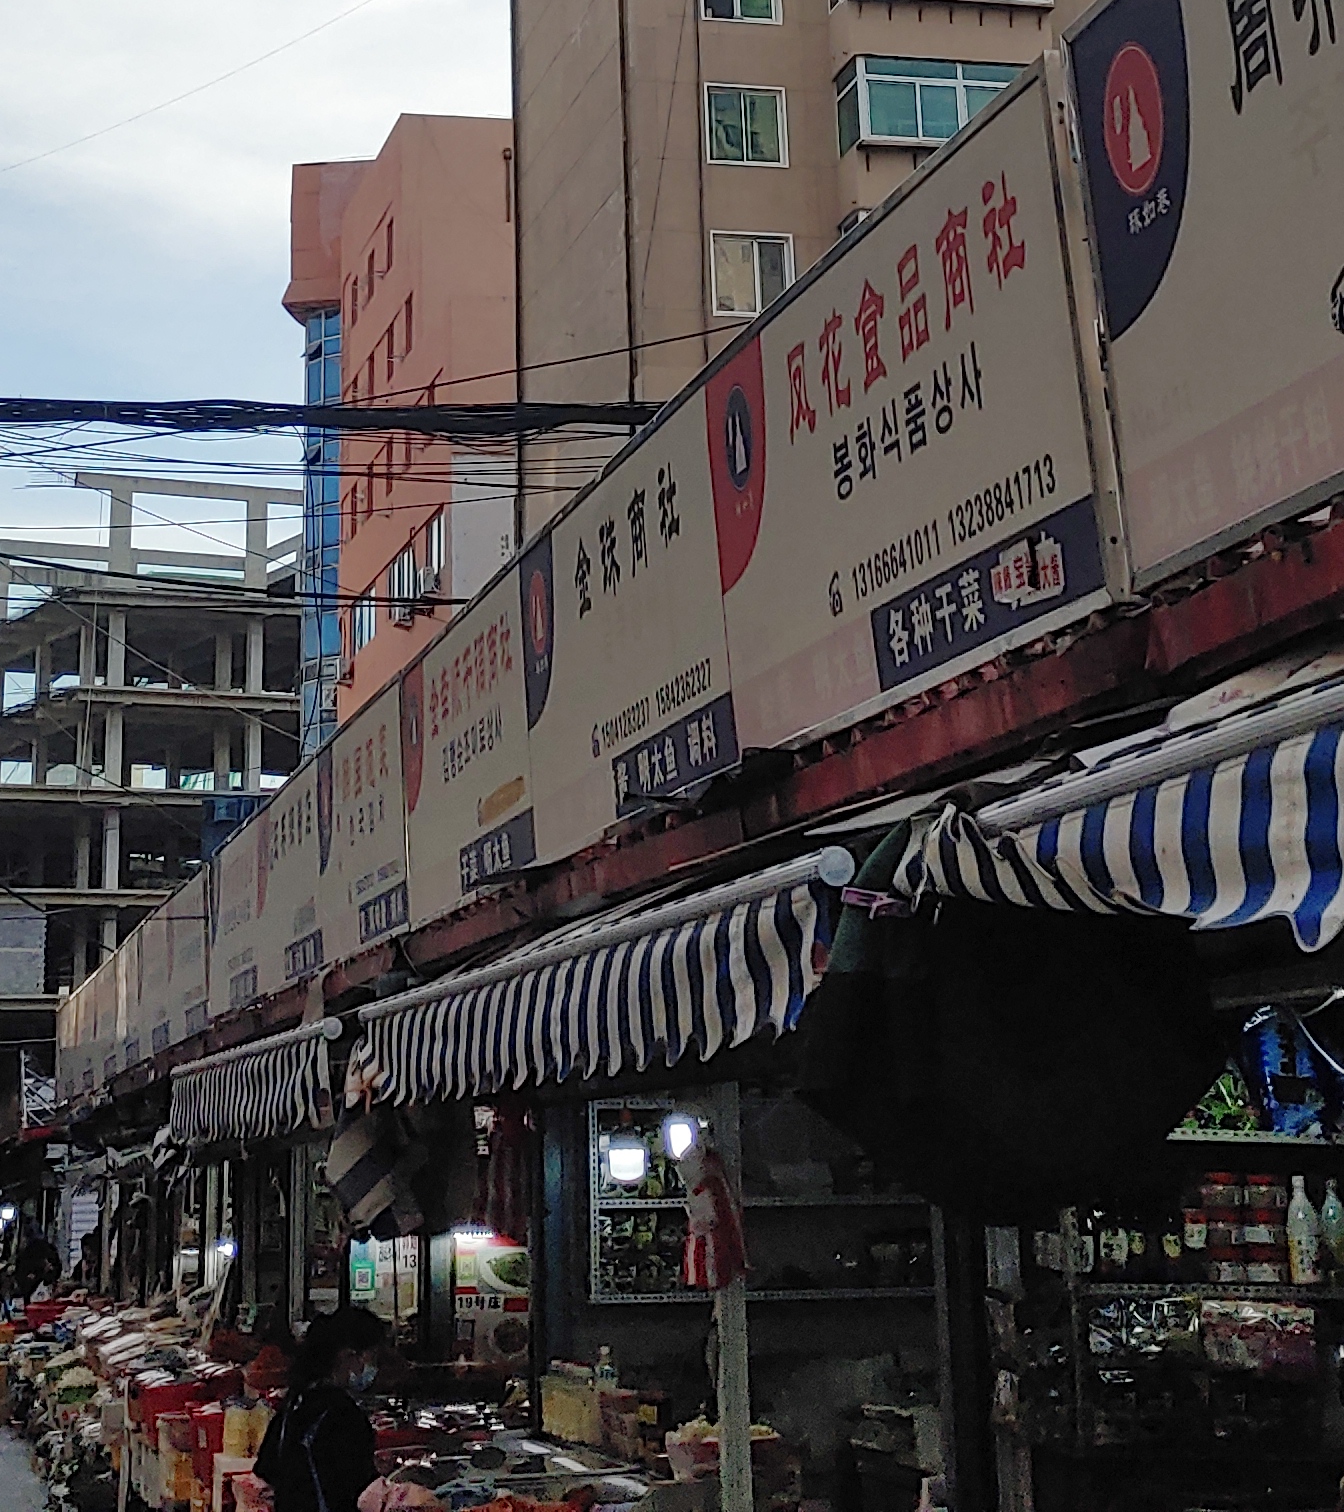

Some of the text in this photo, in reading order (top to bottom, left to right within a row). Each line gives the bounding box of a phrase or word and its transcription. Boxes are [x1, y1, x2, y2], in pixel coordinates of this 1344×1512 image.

[831, 340, 985, 501] 봉화식품상사
[851, 518, 941, 602] 13166641011
[947, 452, 1058, 548] 13238841713
[887, 566, 986, 668] 各种干菜
[402, 1253, 417, 1269] 13
